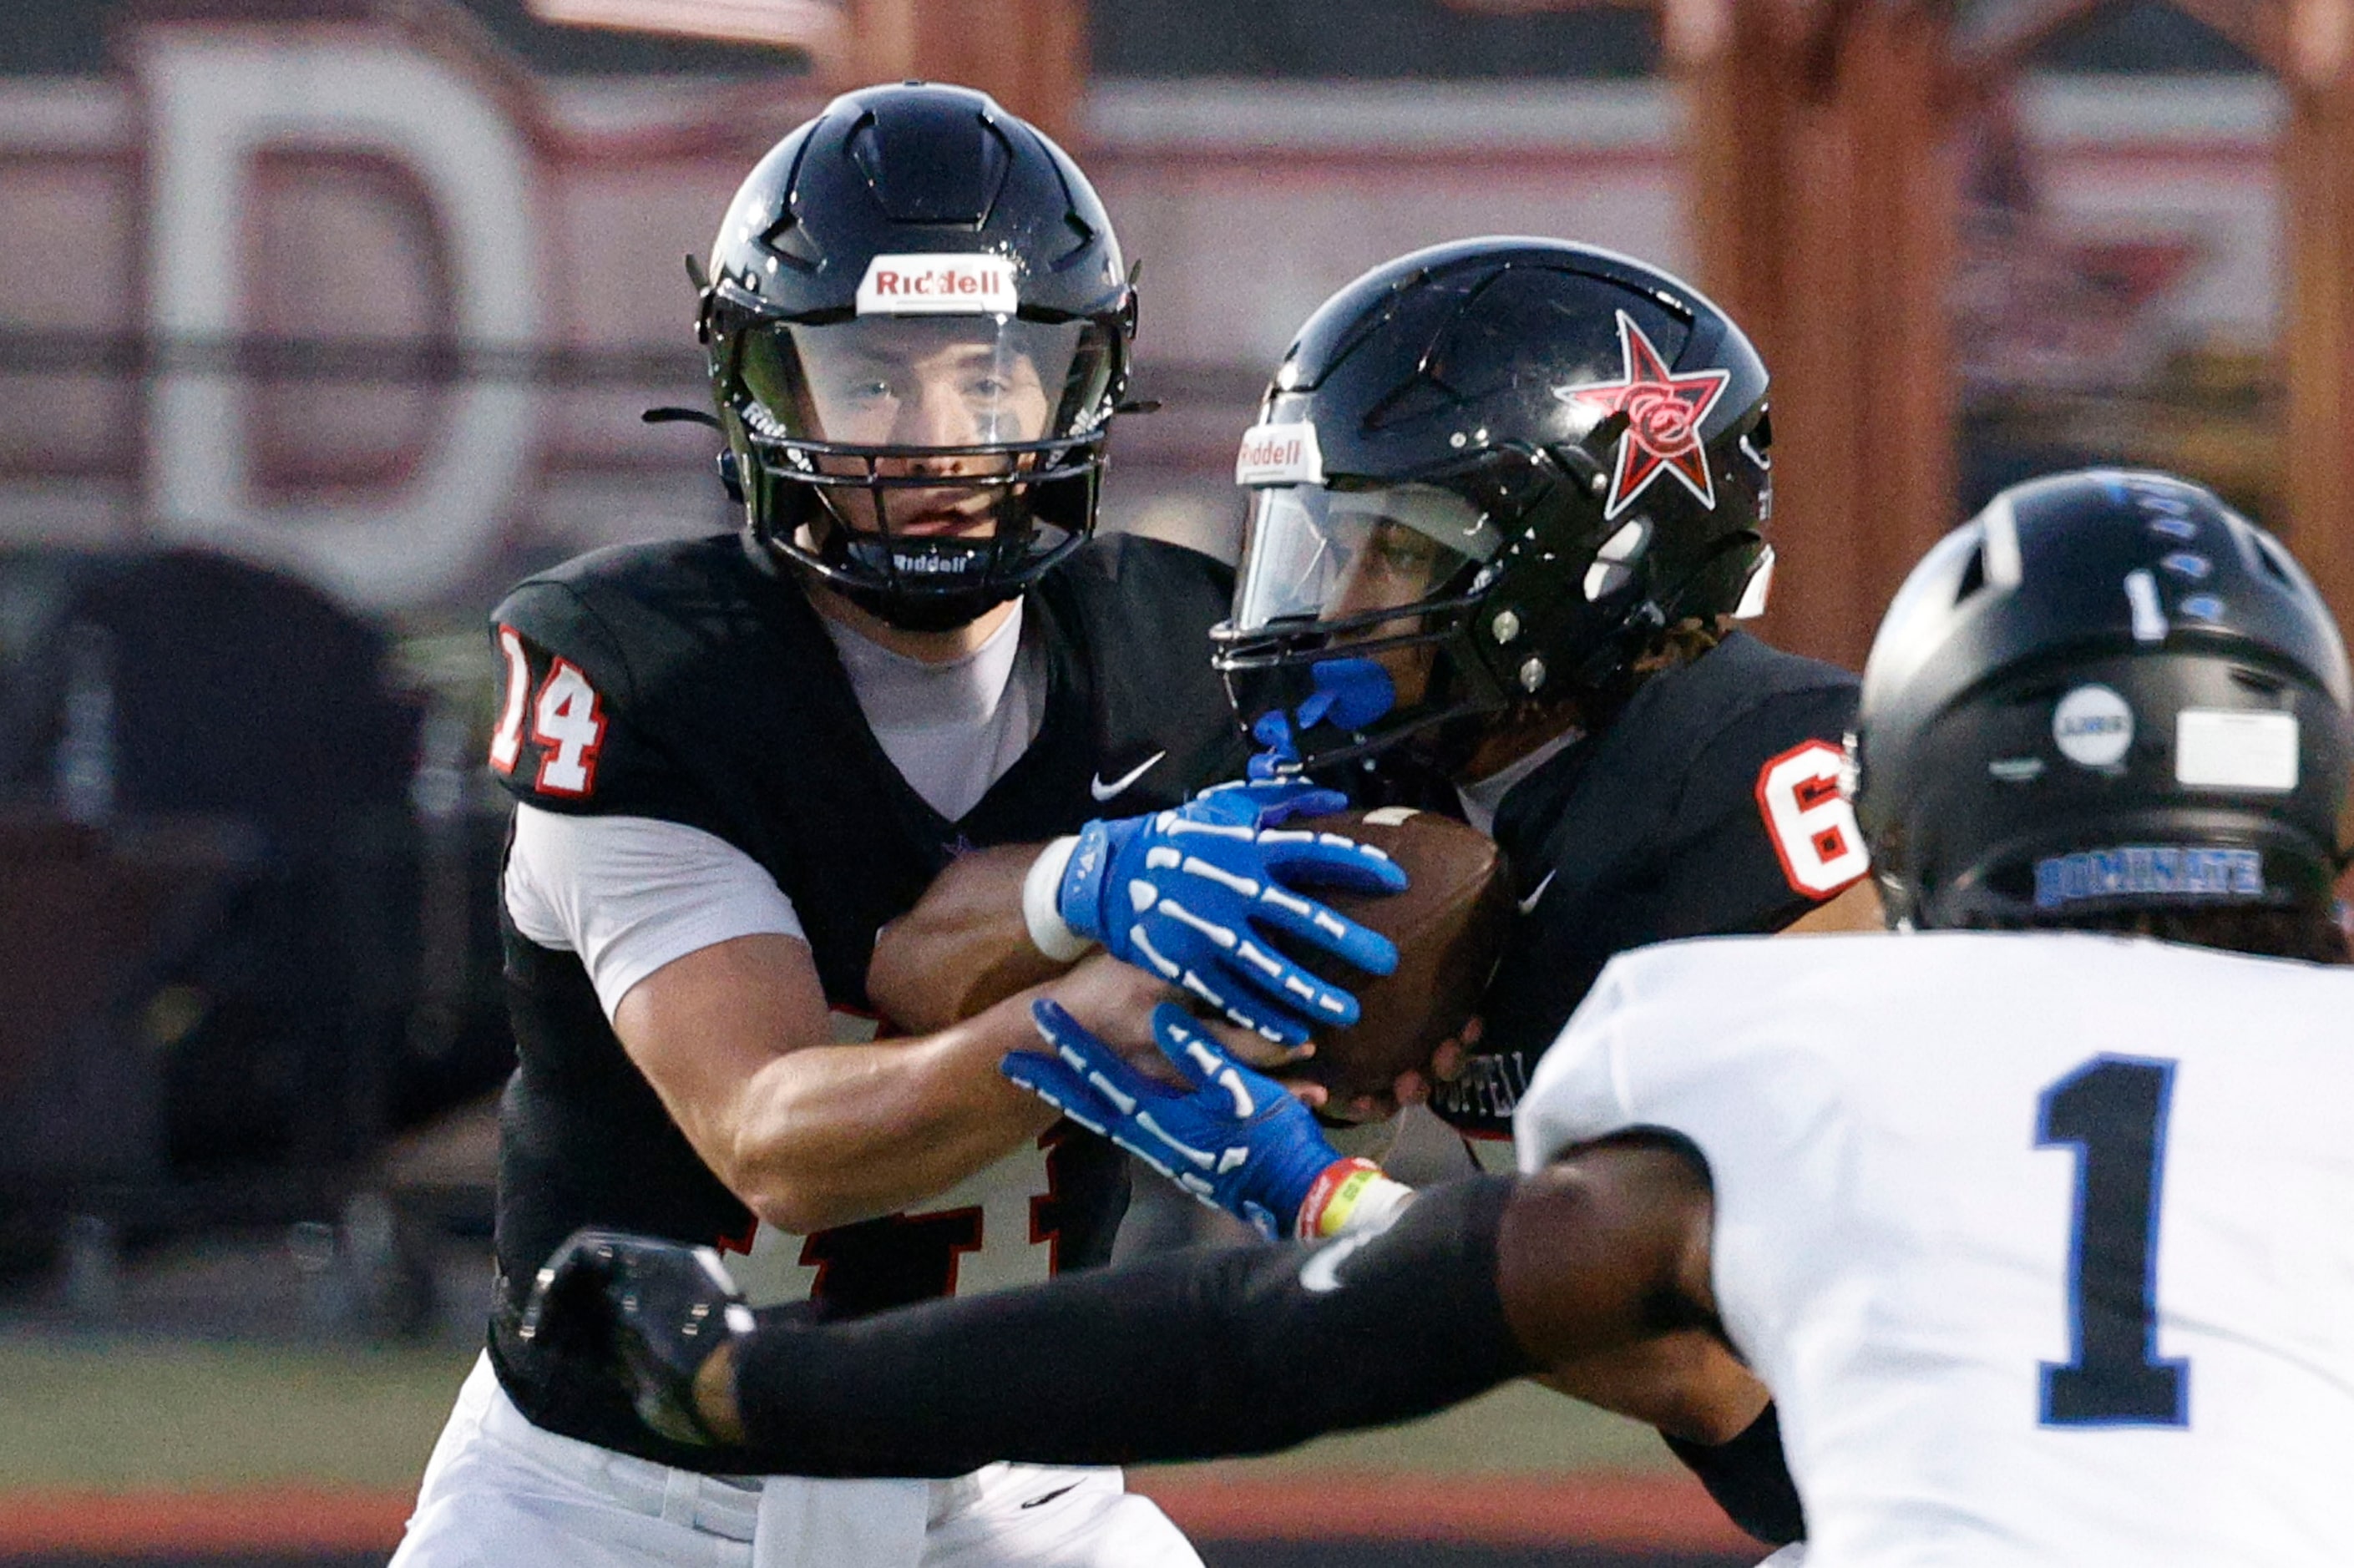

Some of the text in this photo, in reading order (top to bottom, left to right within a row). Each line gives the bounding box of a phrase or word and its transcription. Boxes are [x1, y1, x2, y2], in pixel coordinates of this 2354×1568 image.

[877, 270, 1000, 296] Riddell
[489, 623, 610, 799] 14
[1754, 737, 1876, 898] 6
[2033, 1050, 2191, 1431] 1
